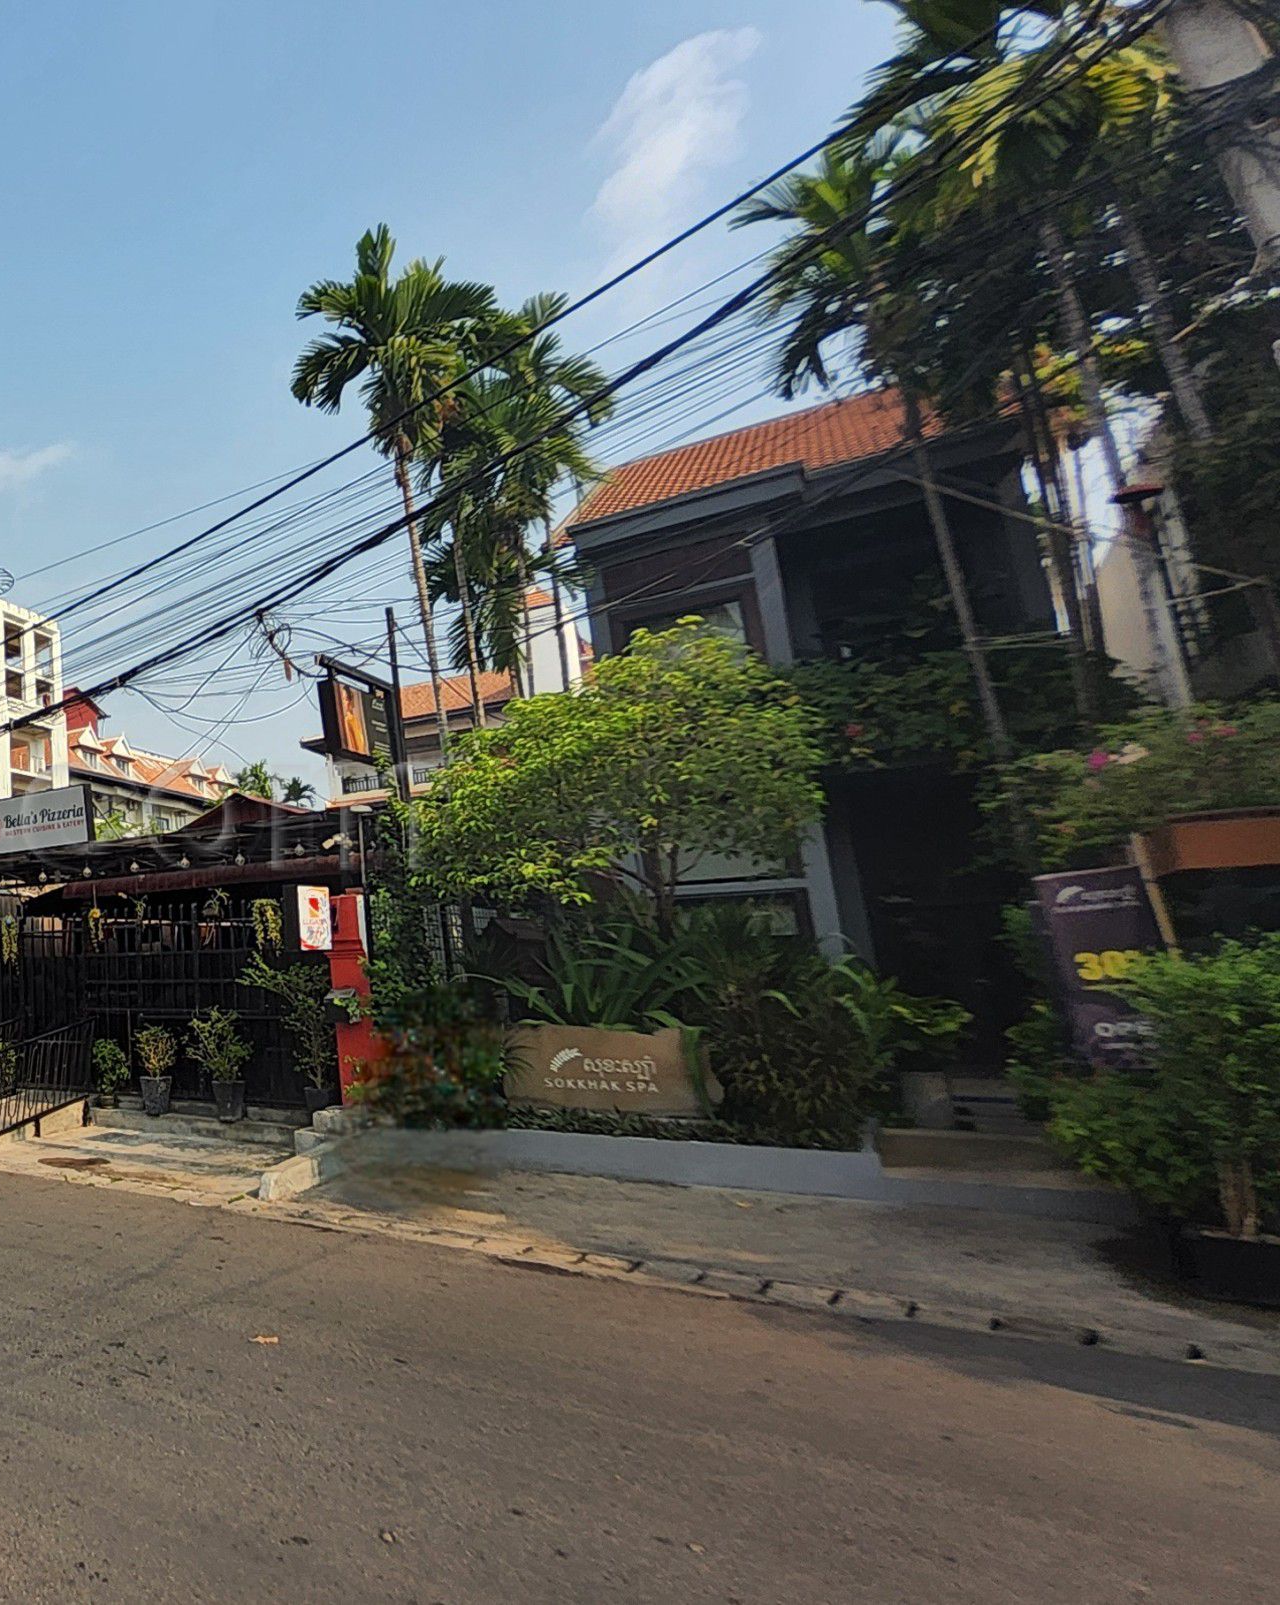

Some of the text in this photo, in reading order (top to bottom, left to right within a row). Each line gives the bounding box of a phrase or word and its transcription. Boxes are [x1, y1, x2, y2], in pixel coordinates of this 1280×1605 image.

[3, 803, 84, 829] Bella's Pizzeria
[32, 824, 55, 833] CUISINE
[63, 819, 84, 828] EATERY
[544, 1077, 660, 1093] SOKKHAK SPA
